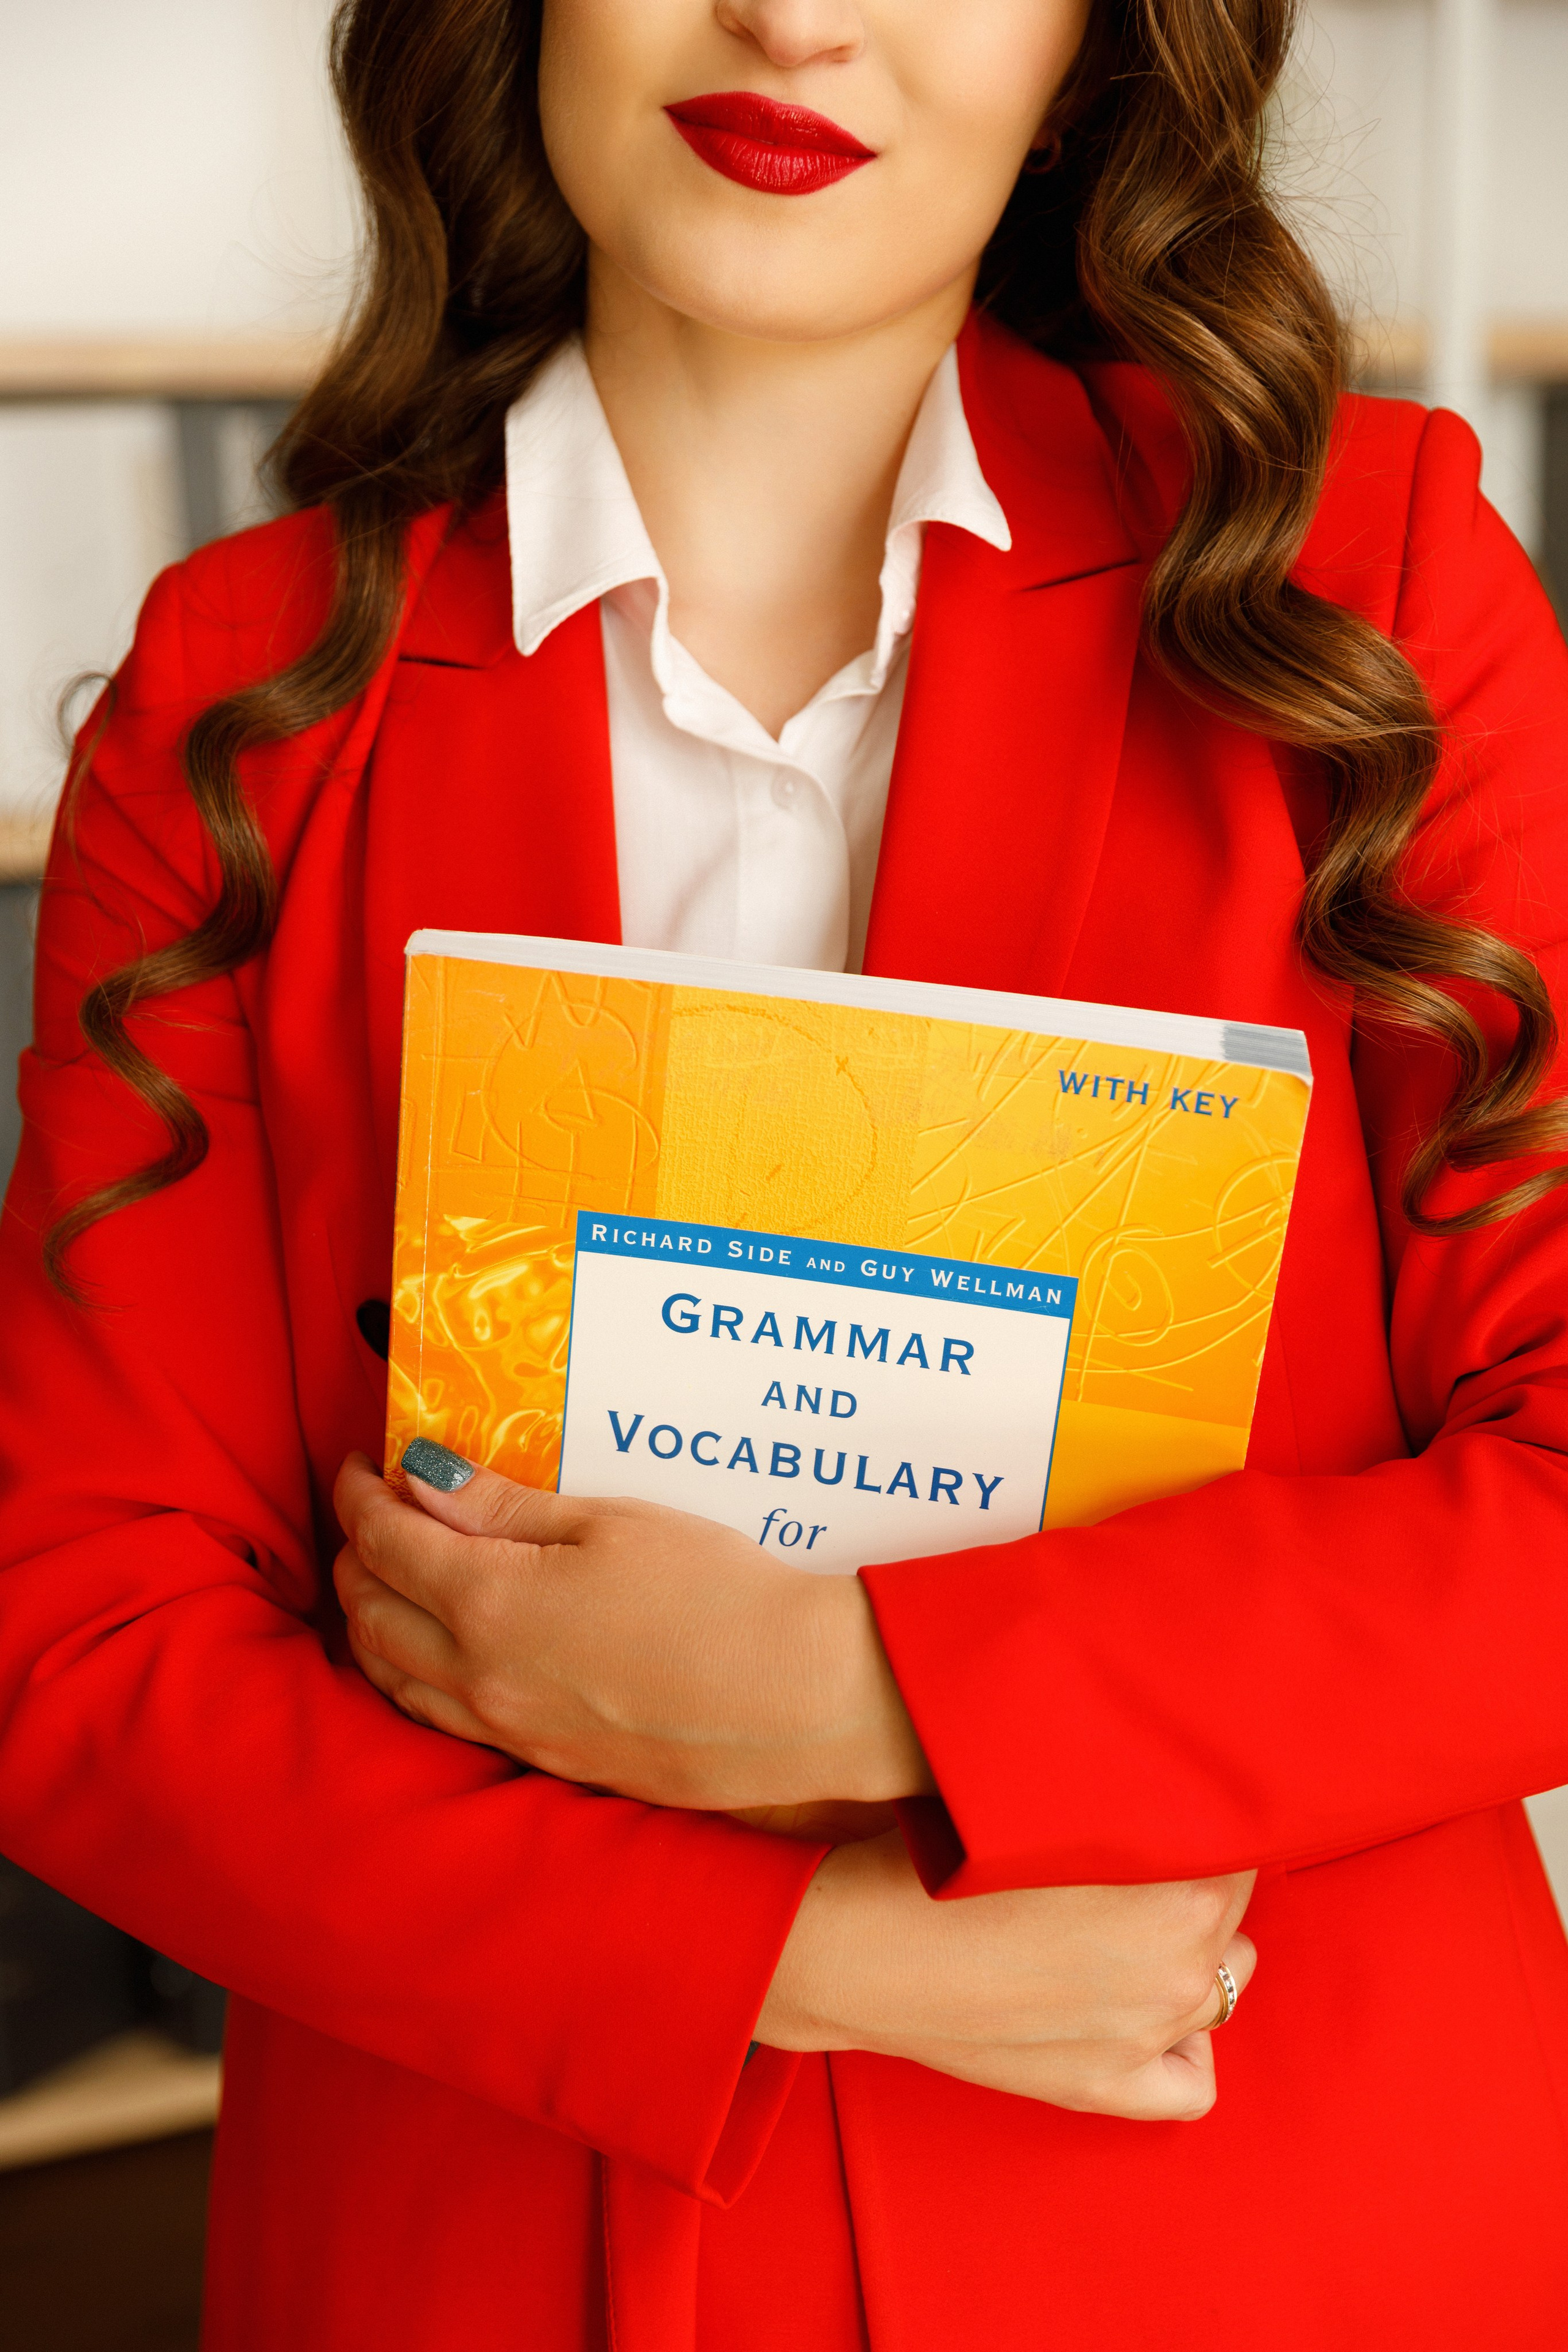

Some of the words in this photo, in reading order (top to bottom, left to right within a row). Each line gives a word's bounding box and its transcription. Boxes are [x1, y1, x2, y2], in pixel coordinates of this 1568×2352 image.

[1059, 1070, 1149, 1104] WITH
[1170, 1087, 1238, 1118] KEY
[592, 1224, 711, 1253] RICHARD
[728, 1241, 791, 1265] SIDE
[807, 1257, 845, 1272] AND
[861, 1260, 914, 1281] GUY
[931, 1269, 1061, 1304] WELLMAN
[662, 1293, 974, 1375] GRAMMAR
[762, 1381, 856, 1418] AND
[608, 1411, 1004, 1510] VOCABULARY
[760, 1509, 826, 1549] for
